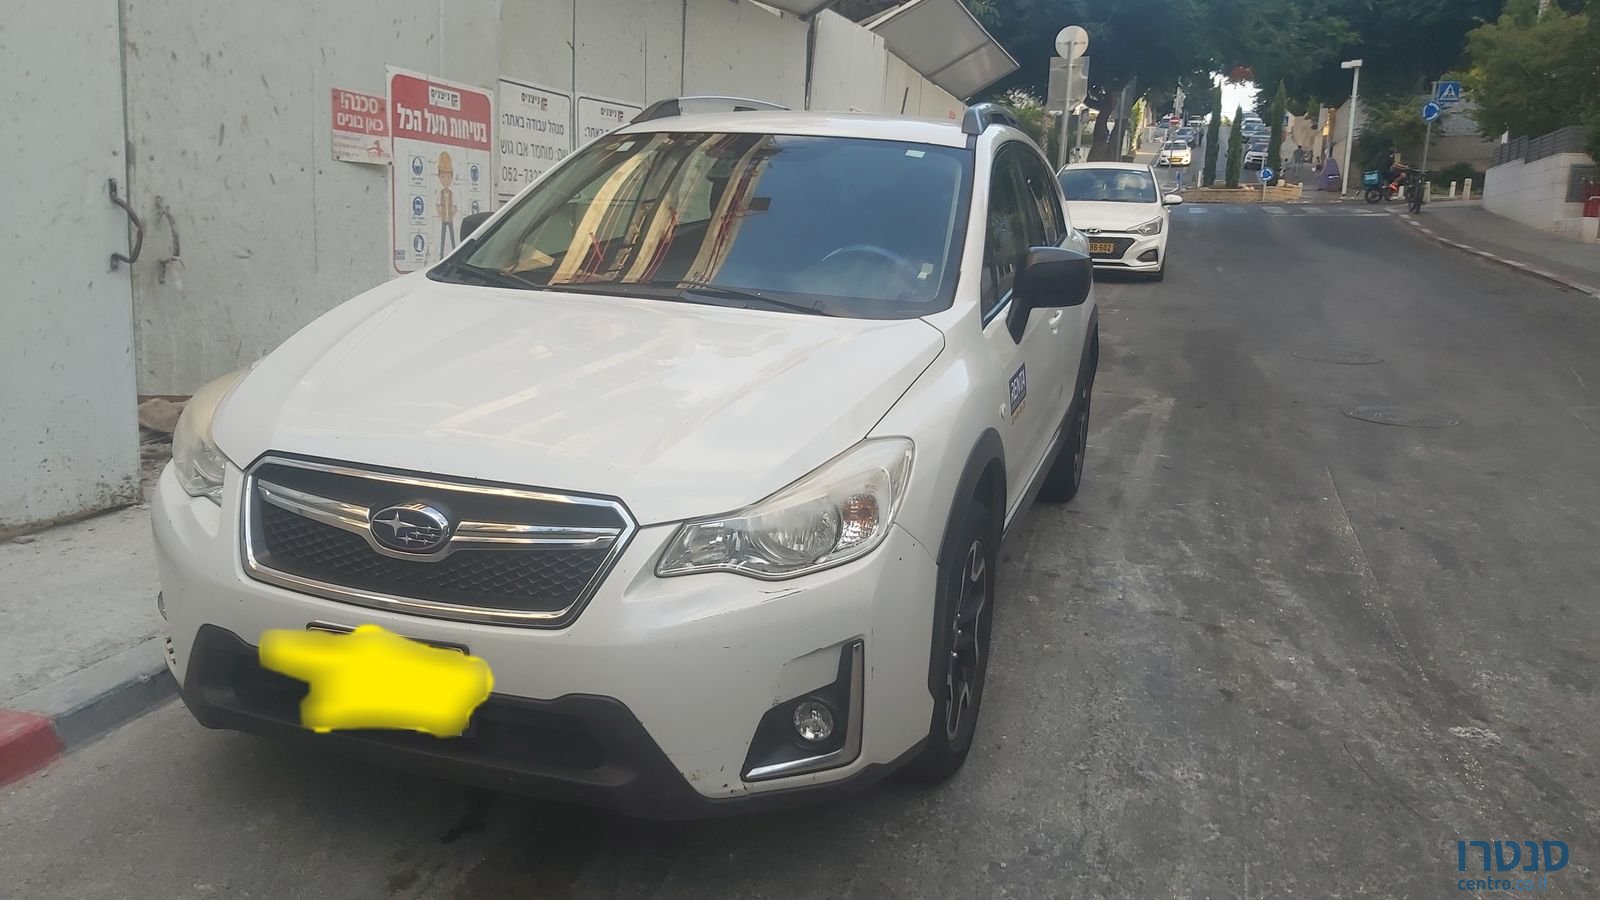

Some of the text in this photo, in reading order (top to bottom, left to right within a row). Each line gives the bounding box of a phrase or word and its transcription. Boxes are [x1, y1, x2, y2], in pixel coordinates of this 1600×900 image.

[340, 92, 379, 114] סכנה!
[337, 112, 384, 133] כאן בונים
[397, 103, 488, 143] בטיחות מעל הכל
[502, 113, 565, 136] מנהל עבודה באתר:
[516, 141, 529, 158] אבו
[530, 143, 553, 160] מוחמד
